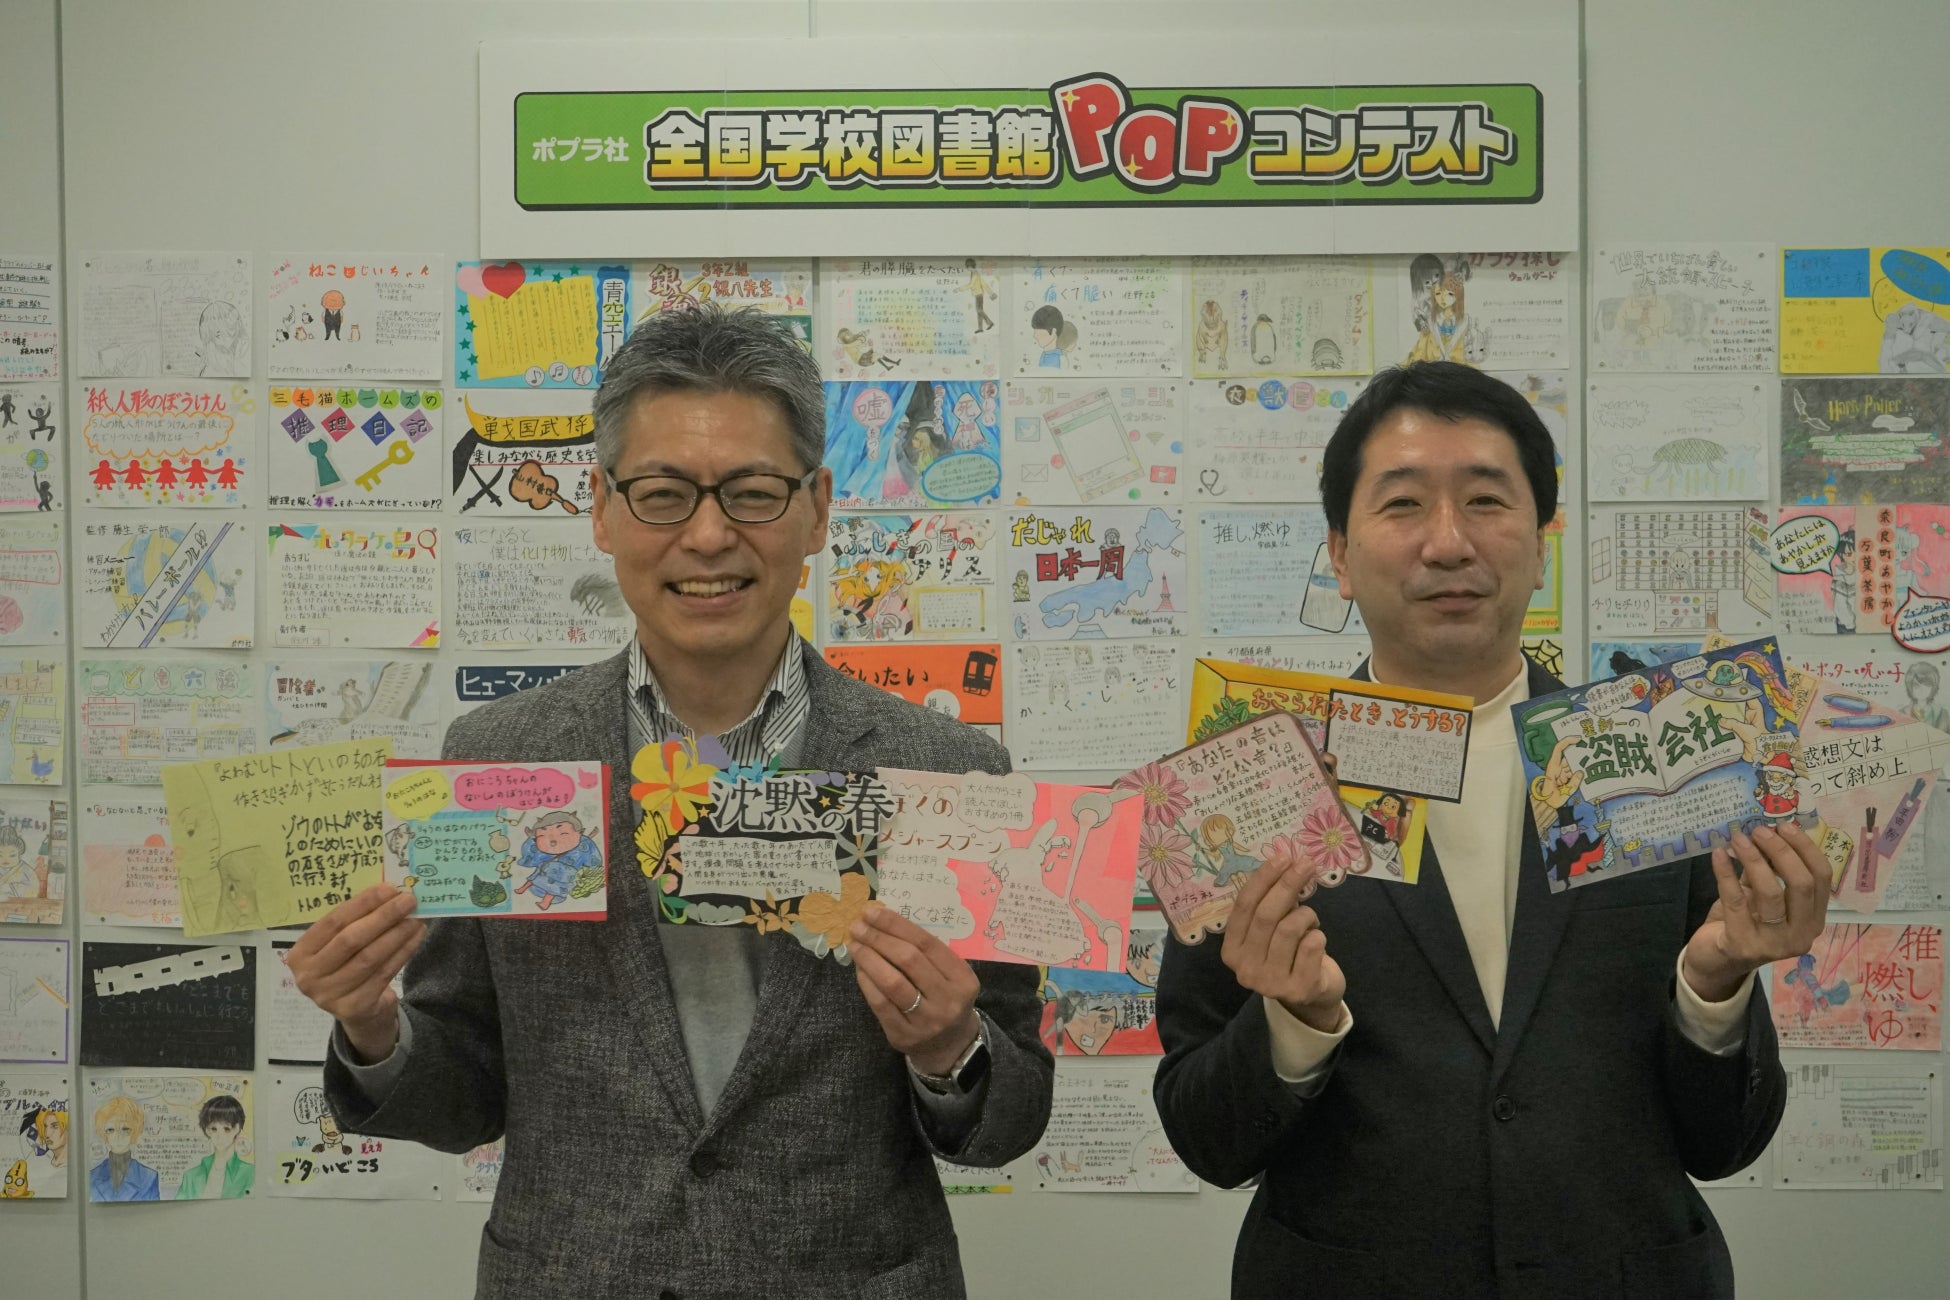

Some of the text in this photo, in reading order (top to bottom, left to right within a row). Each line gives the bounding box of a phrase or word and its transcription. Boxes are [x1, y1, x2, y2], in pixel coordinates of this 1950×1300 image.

[532, 78, 1516, 187] ポプラ社 全国学校図書館 POP コンテスト
[712, 278, 773, 299] 銀八先生
[87, 387, 227, 414] 紙人形のぼうけん
[273, 390, 440, 409] 三毛猫ホームズの
[288, 415, 430, 438] 推理日記
[483, 414, 587, 441] 戦国武将
[457, 527, 535, 546] 夜になると
[1010, 513, 1096, 548] だじゃれ
[1775, 518, 1828, 552] あなたには
[490, 543, 614, 562] 僕は化け物になる
[1778, 532, 1828, 565] あやかしが
[1794, 544, 1835, 572] 見えますか
[911, 555, 983, 582] アリス
[1035, 545, 1126, 582] 日本一周
[1251, 687, 1468, 738] おこられたとき、どうする?
[1579, 718, 1641, 742] 星新一の
[1656, 704, 1737, 767] 会社
[1576, 735, 1658, 785] 盗賊
[1802, 734, 1884, 771] 感想文は
[1810, 757, 1909, 798] って斜め上
[708, 776, 897, 834] 沈黙の春
[892, 792, 955, 818] ぼくの
[879, 828, 1003, 854] メジャースプーン
[1860, 961, 1906, 1048] 燃ゆ
[281, 1156, 380, 1182] ブタのいどころ
